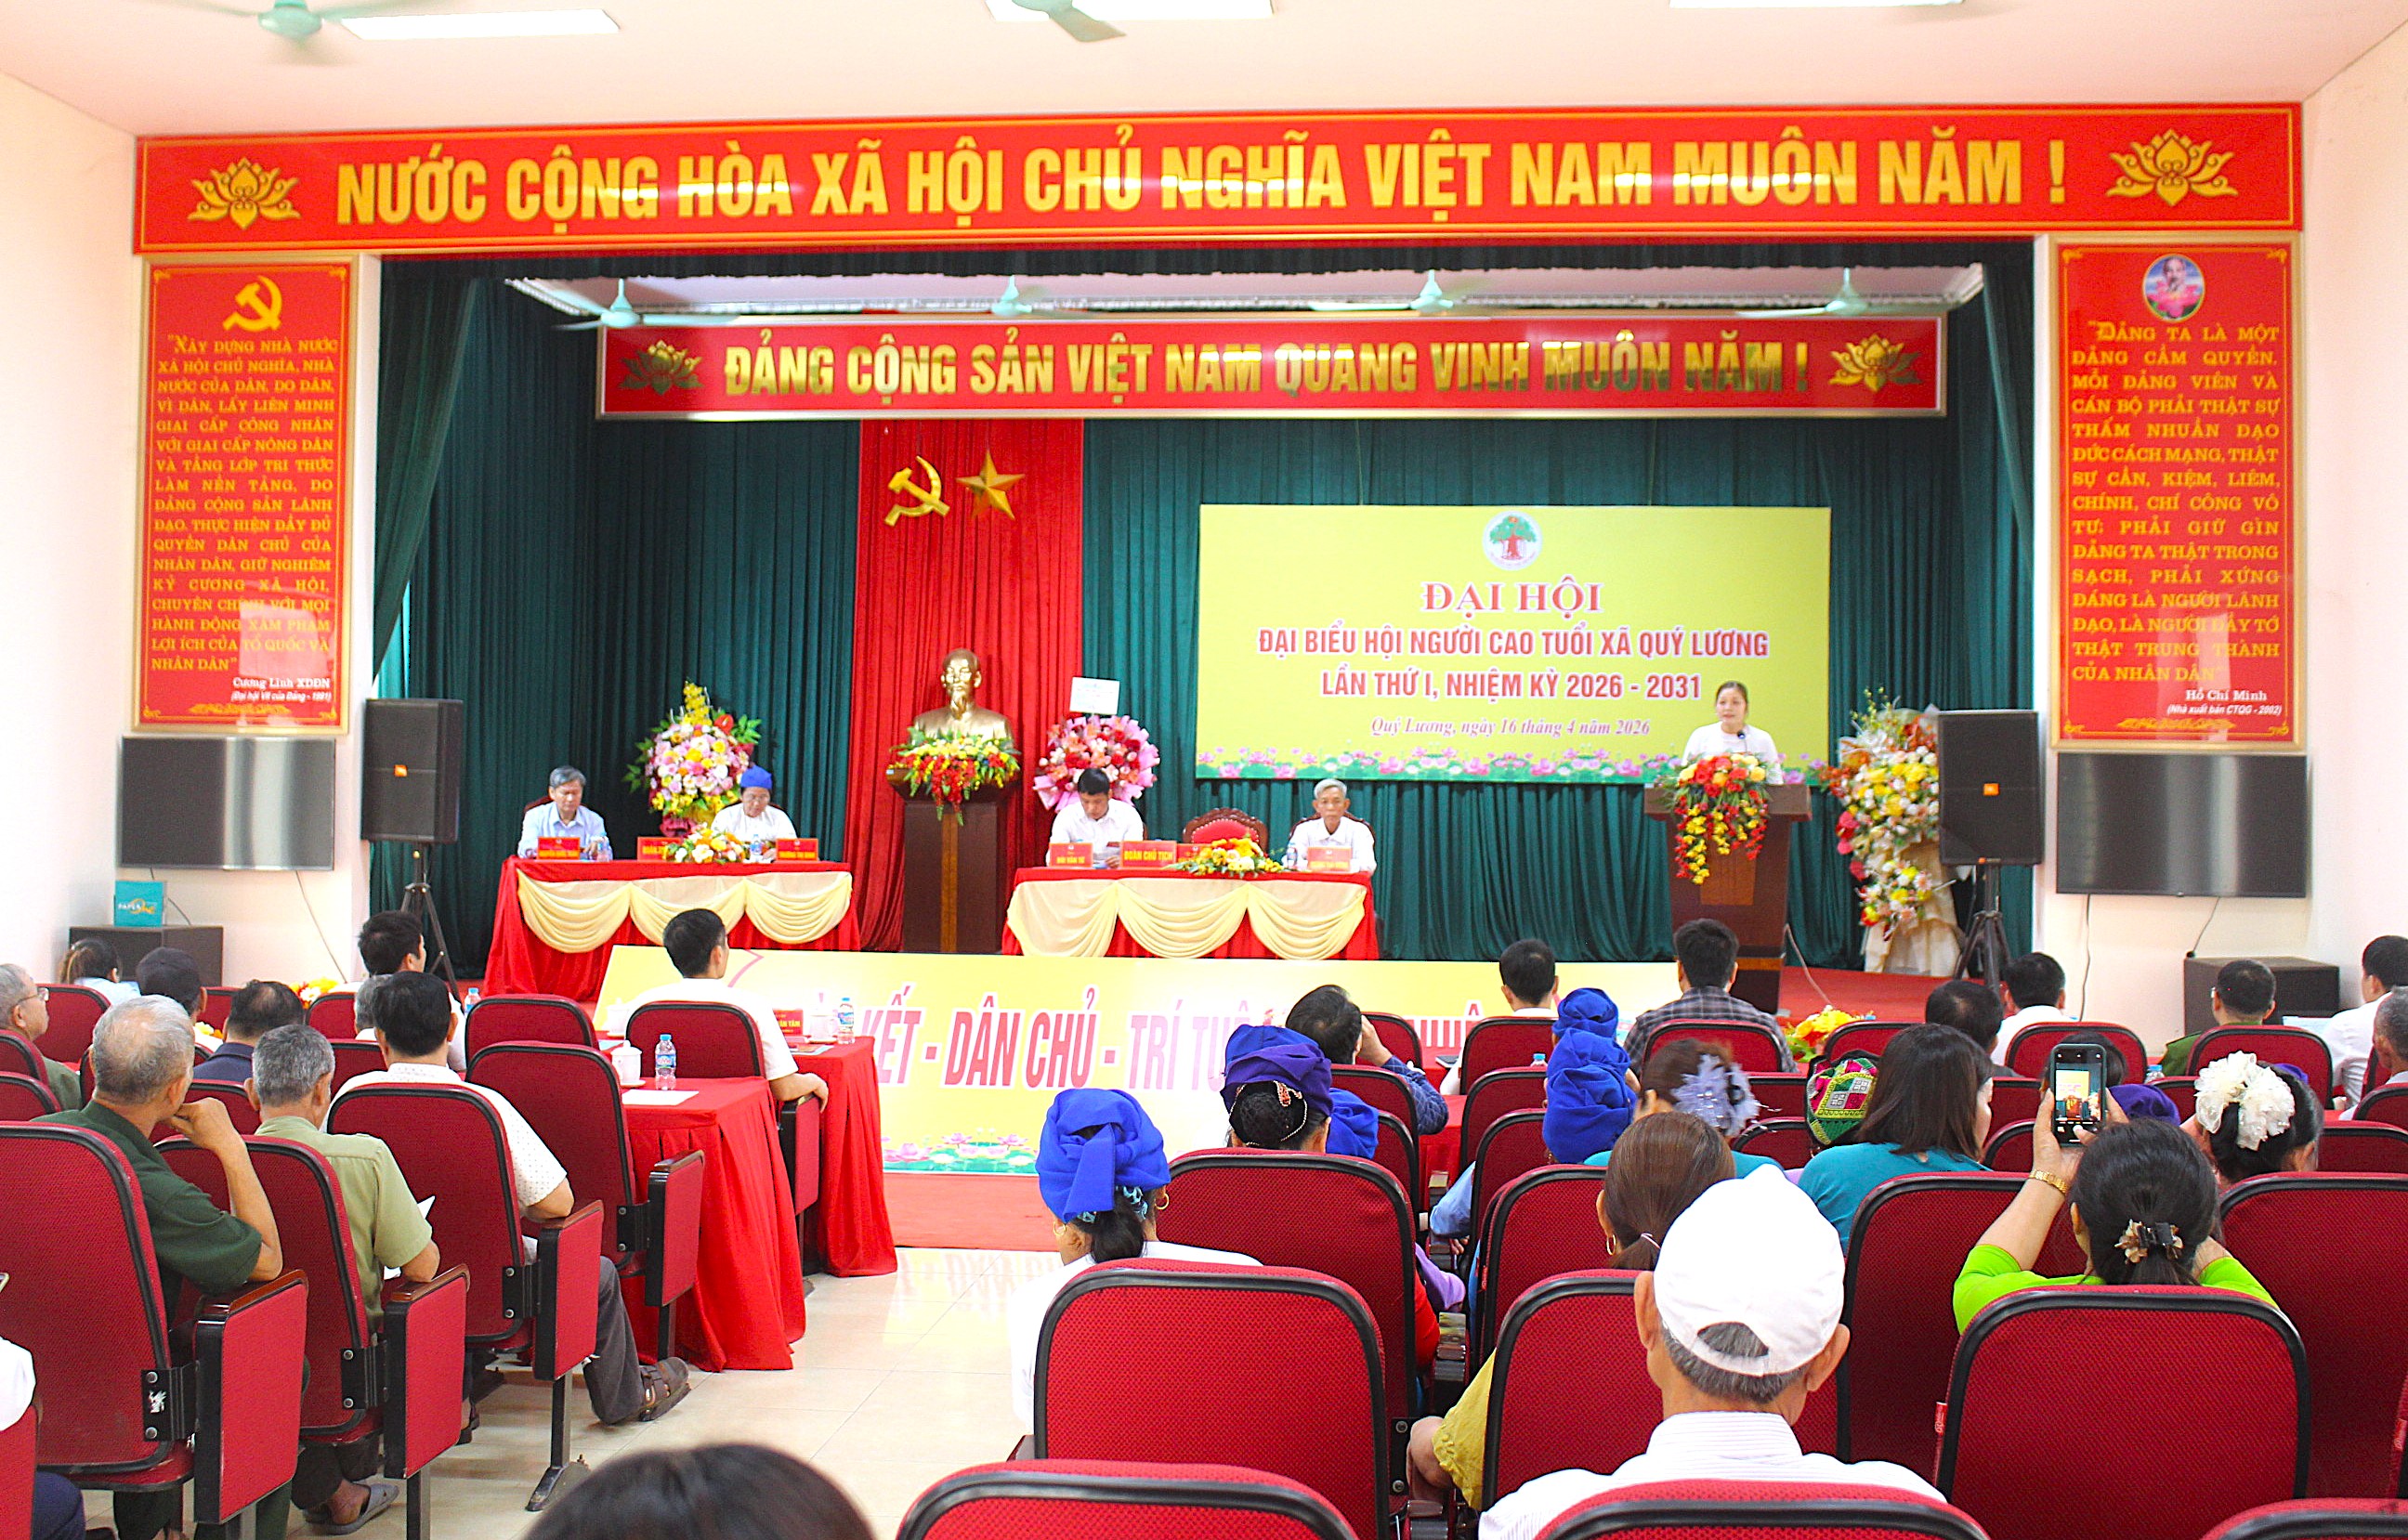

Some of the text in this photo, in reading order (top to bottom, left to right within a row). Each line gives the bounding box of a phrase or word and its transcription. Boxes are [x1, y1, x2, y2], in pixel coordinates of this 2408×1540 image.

[336, 142, 488, 226] NƯỚC
[506, 143, 660, 236] CỘNG
[677, 139, 794, 217] HÒA
[809, 137, 890, 216] XÃ
[907, 136, 1003, 228] HỘI
[1024, 123, 1143, 213] CHỦ
[1159, 128, 1347, 211] NGHĨA
[1365, 127, 1492, 222] VIỆT
[1511, 141, 1654, 208] NAM
[1673, 124, 1859, 208] MUÔN
[1878, 124, 2022, 205] NĂM
[724, 328, 835, 396] ĐẢNG
[846, 333, 958, 405] CỘNG
[969, 326, 1055, 395] SẢN
[1066, 333, 1154, 405] VIỆT
[1164, 343, 1262, 393] NAM
[1274, 342, 1419, 397] QUANG
[1430, 341, 1530, 392] VINH
[1542, 329, 1671, 392] MUÔN
[1683, 330, 1783, 392] NĂM
[1424, 576, 1602, 619] ĐẠI HỘI
[1260, 620, 1770, 659] ĐẠI BIỂU HỘI NGƯỜI CAO TUỔI XÃ QUÝ LƯƠNG
[1322, 663, 1366, 695] LẦN
[1375, 668, 1420, 696] THỨ
[1425, 673, 1438, 698] I,
[1446, 669, 1522, 701] NHIỆM
[1530, 671, 1559, 698] KỲ
[1566, 674, 1623, 698] 2026
[1646, 675, 1700, 698] 2031
[2207, 690, 2229, 701] Chí
[2232, 690, 2268, 701] Minh
[1371, 717, 1401, 736] Quý
[1461, 721, 1497, 737] ngày
[1501, 719, 1517, 734] 16
[1521, 719, 1563, 737] tháng
[1566, 722, 1577, 734] 4
[1579, 721, 1612, 735] năm
[1616, 720, 1651, 735] 2026
[944, 995, 1021, 1087] DÂN
[1026, 986, 1098, 1089] CHỦ
[1129, 998, 1184, 1090] TRÍ
